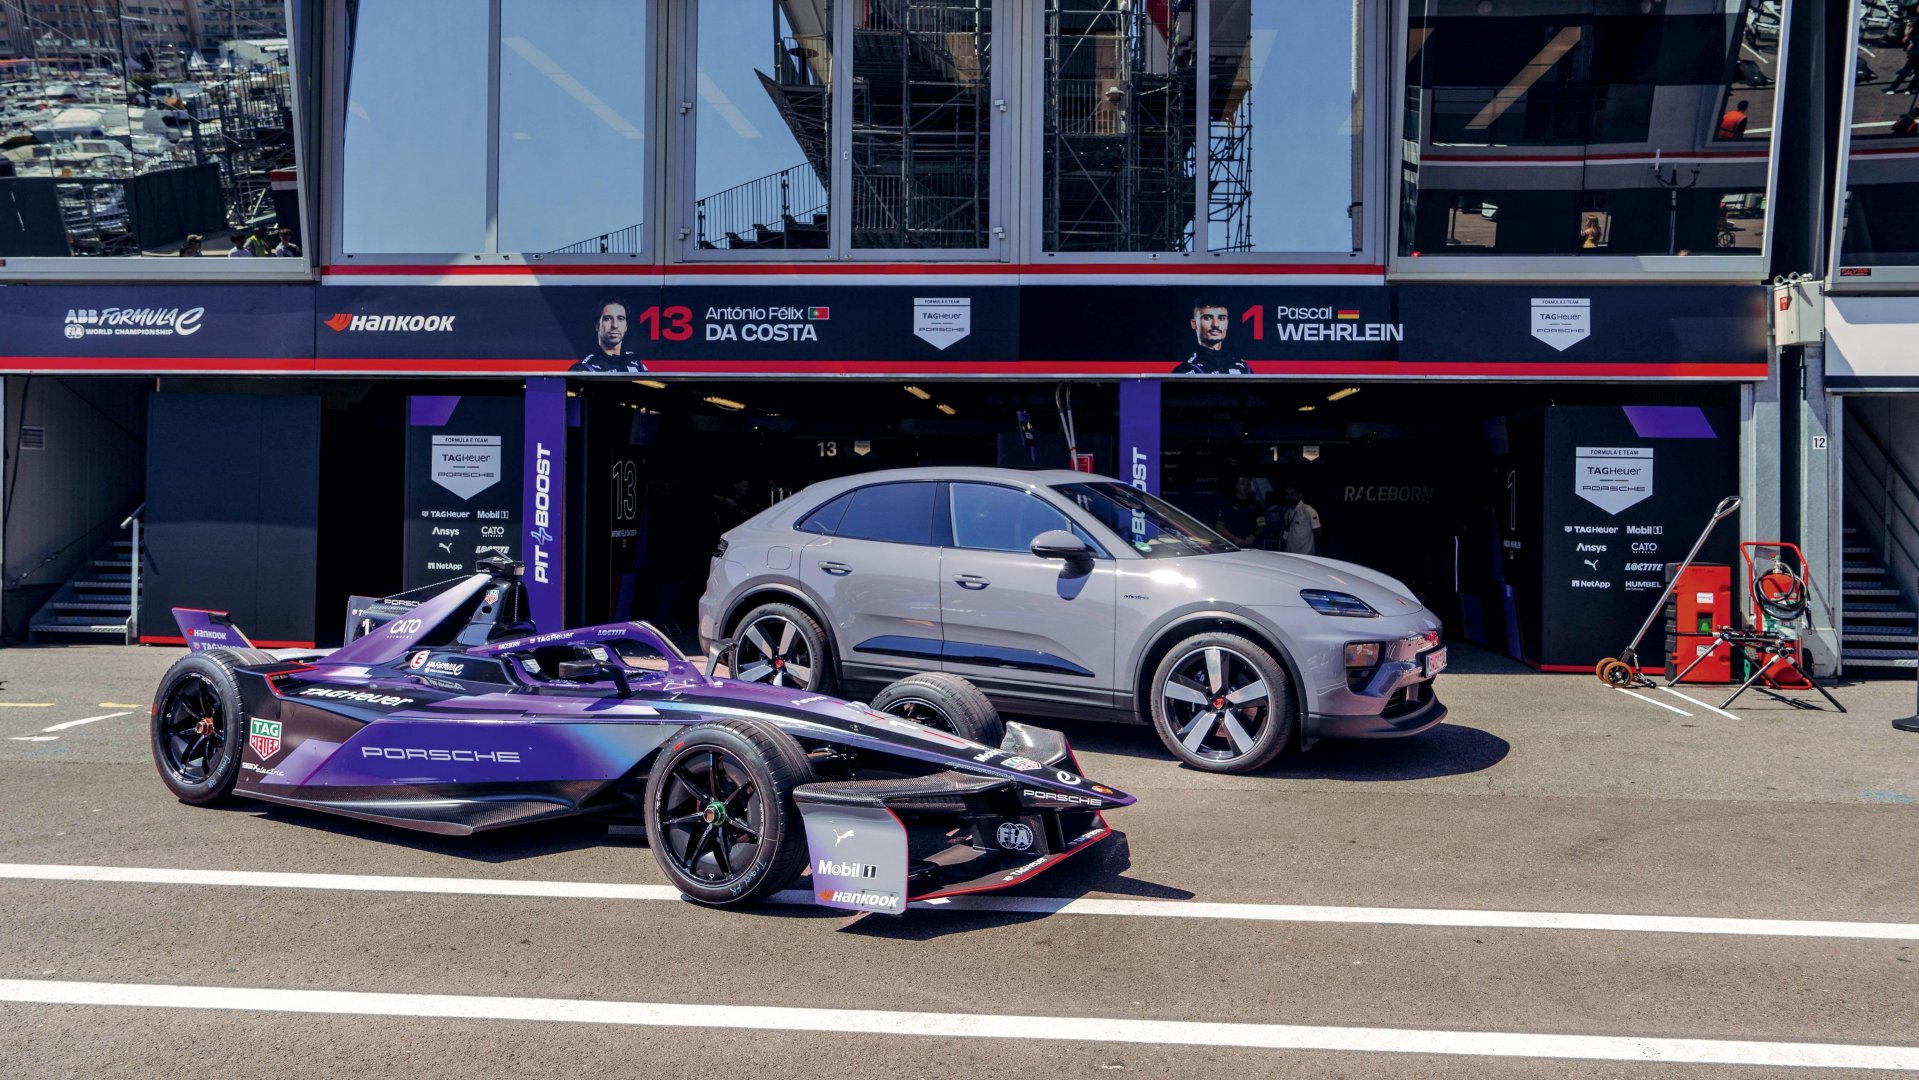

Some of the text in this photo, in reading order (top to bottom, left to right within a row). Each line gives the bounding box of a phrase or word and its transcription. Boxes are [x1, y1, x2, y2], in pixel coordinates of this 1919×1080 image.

[64, 309, 98, 324] ABB
[98, 308, 178, 326] FORMULA
[705, 306, 803, 320] António Félix
[1278, 305, 1332, 320] Pascal
[640, 306, 693, 341] 13
[1242, 304, 1264, 340] 1
[706, 324, 818, 342] DA COSTA
[1277, 323, 1404, 341] WEHRLEIN
[817, 441, 837, 457] 13
[1814, 438, 1825, 448] 12
[442, 454, 490, 462] TAGHeuer
[1270, 445, 1278, 461] 1
[1587, 467, 1641, 475] TAGHeuer
[536, 442, 551, 528] BOOST
[612, 460, 637, 520] 13
[1508, 470, 1516, 530] 1
[432, 527, 460, 536] Ansys
[481, 526, 504, 535] CATO
[1627, 526, 1652, 534] Mobil
[1576, 543, 1607, 553] Ansys
[1632, 543, 1657, 551] CATO
[436, 562, 462, 571] NetApp
[535, 544, 548, 583] PIT
[362, 618, 370, 635] 1
[390, 619, 421, 634] CATO
[300, 688, 414, 706] TAGHeuer
[254, 721, 279, 736] TAG
[252, 736, 279, 756] HEUER
[361, 747, 520, 763] PORSCHE
[1024, 790, 1102, 806] PORSCHE
[818, 860, 860, 877] Mobil
